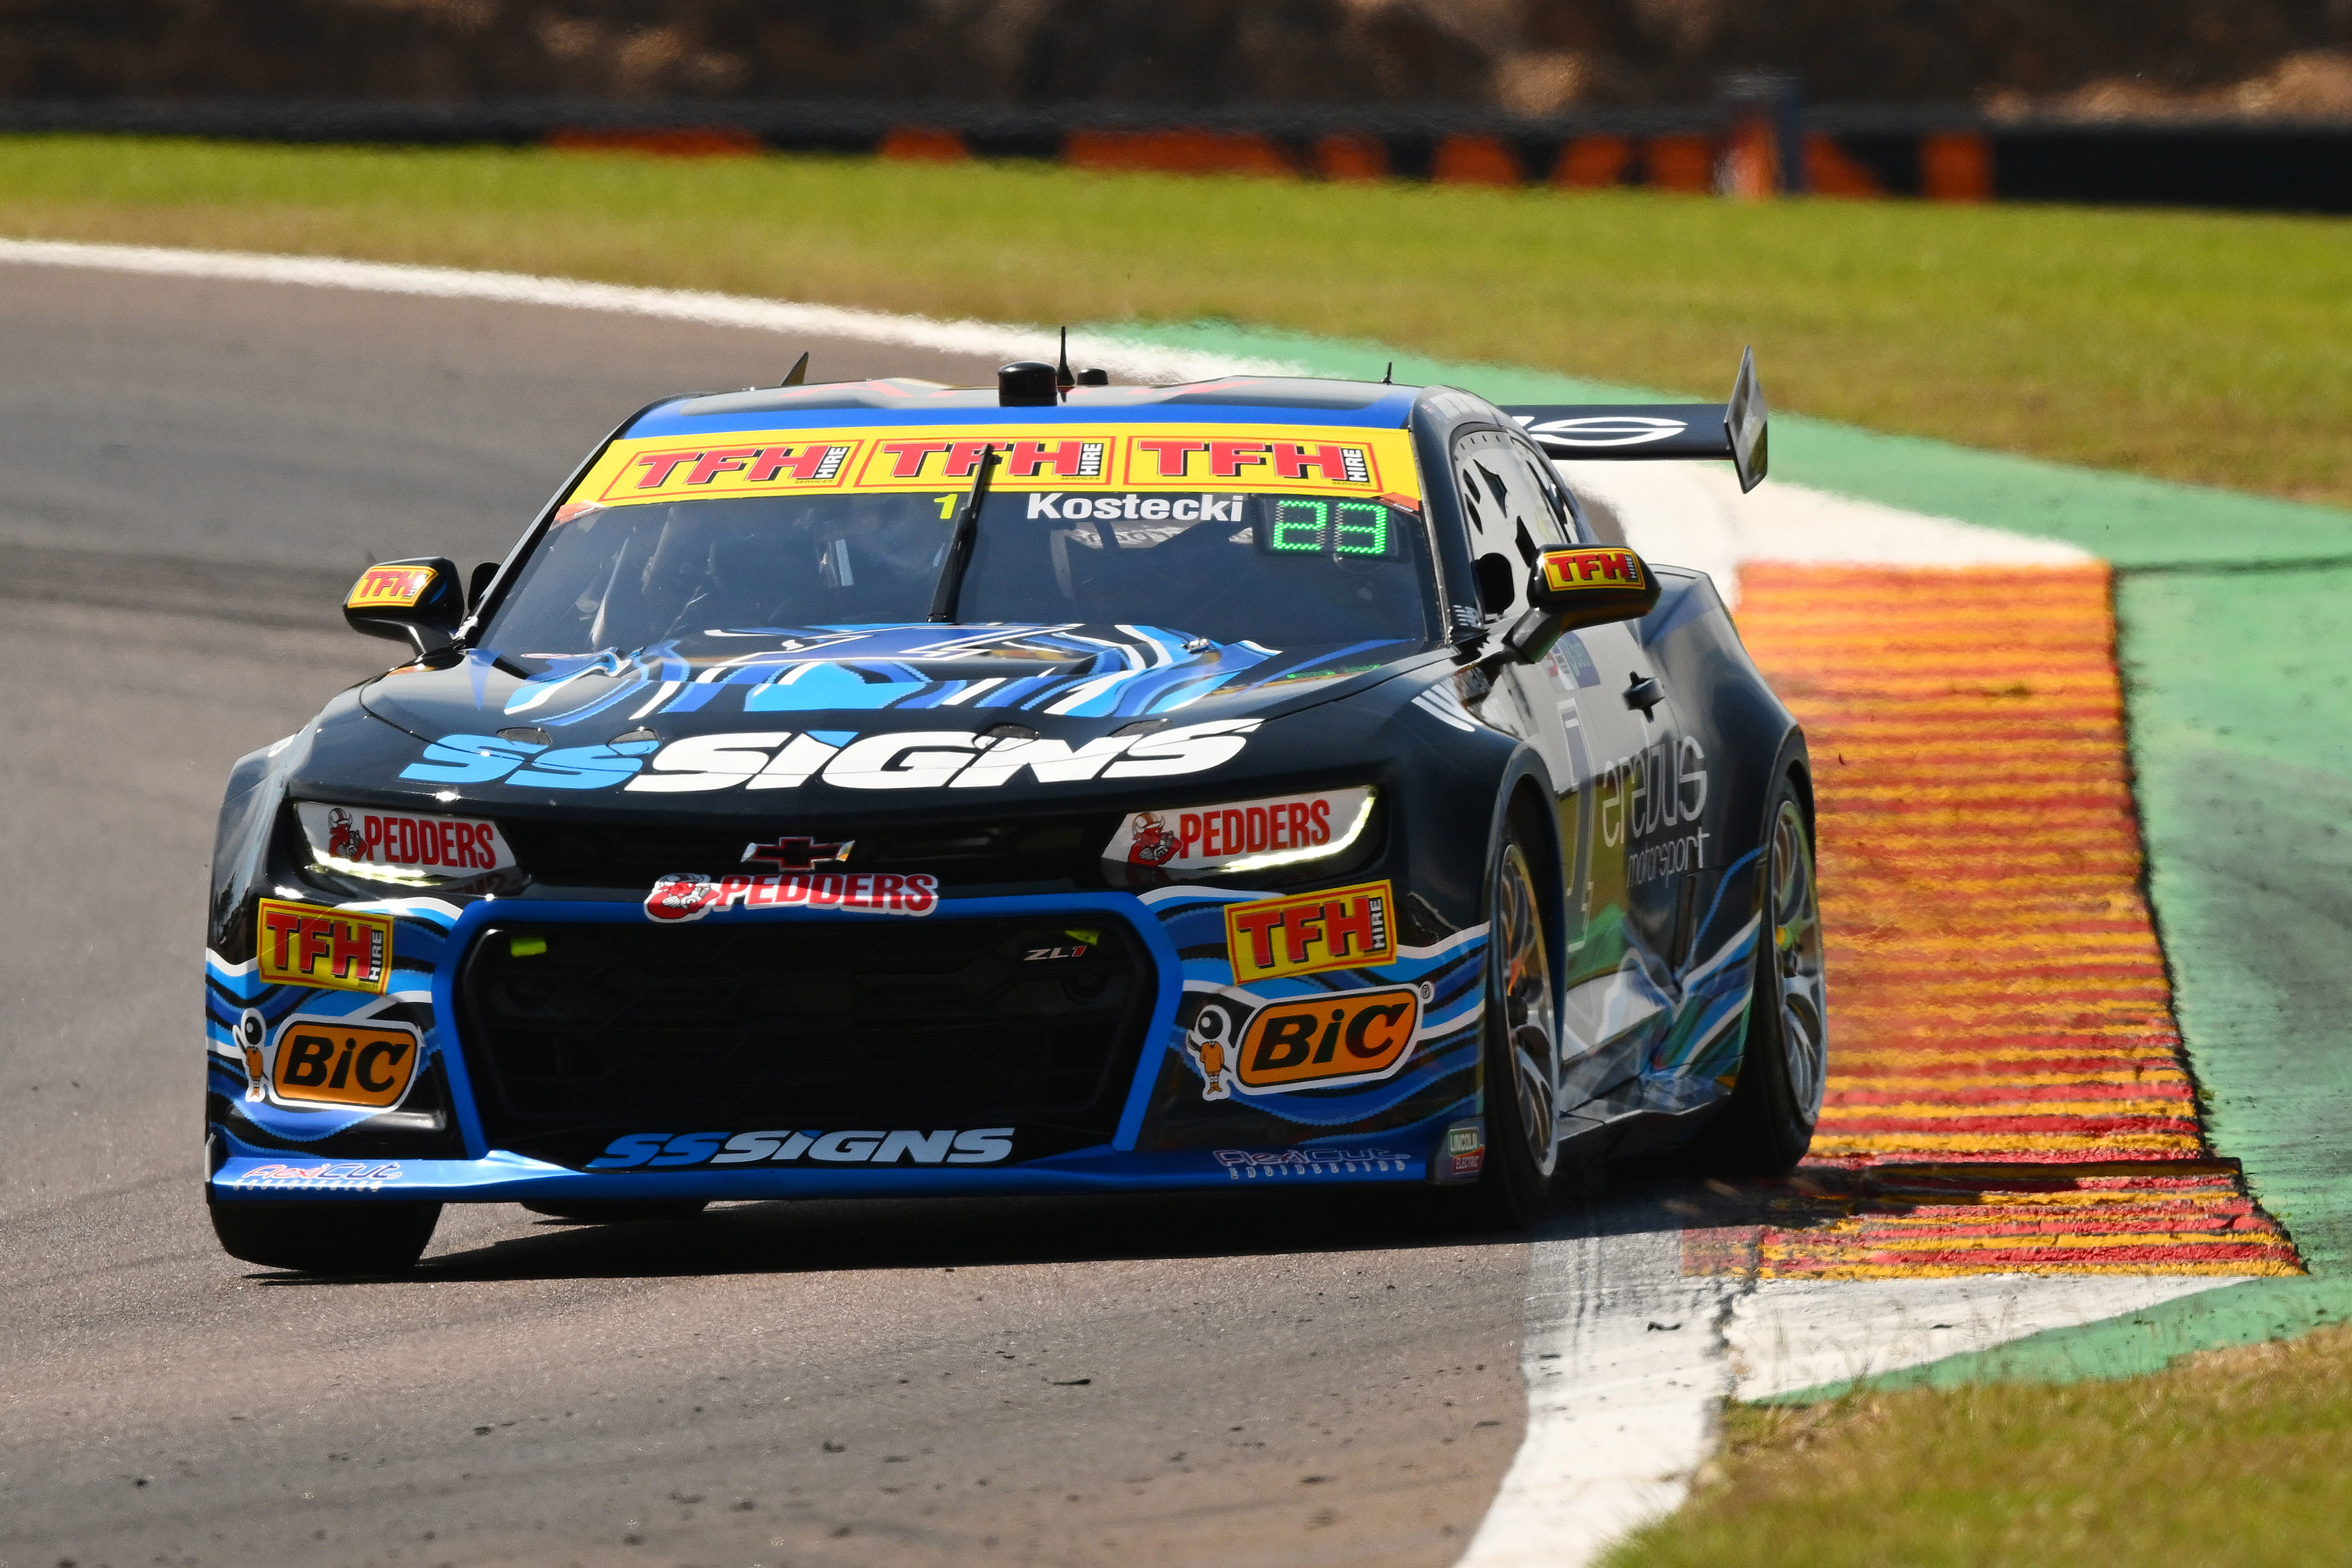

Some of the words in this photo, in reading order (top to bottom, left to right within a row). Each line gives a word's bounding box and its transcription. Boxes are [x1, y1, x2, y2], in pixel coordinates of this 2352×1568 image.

[635, 445, 831, 489] TFH
[815, 447, 848, 478] HIRE
[881, 441, 1083, 477] TFH
[1079, 443, 1103, 476] HIRE
[1138, 440, 1348, 481] TFH
[1343, 448, 1368, 482] HIRE
[934, 493, 958, 519] 1
[1026, 493, 1243, 522] Kostecki
[1273, 500, 1387, 554] 23
[360, 571, 419, 597] TFH
[1549, 553, 1631, 581] TFH
[1624, 554, 1637, 579] HIRE
[364, 815, 497, 869] PEDDERS
[1179, 799, 1331, 859] PEDDERS
[713, 873, 934, 913] PEDDERS
[266, 911, 372, 980] TFH
[369, 931, 383, 981] HIRE
[1236, 896, 1374, 968] TFH
[1370, 897, 1385, 948] HIRE
[1023, 945, 1087, 961] ZL1
